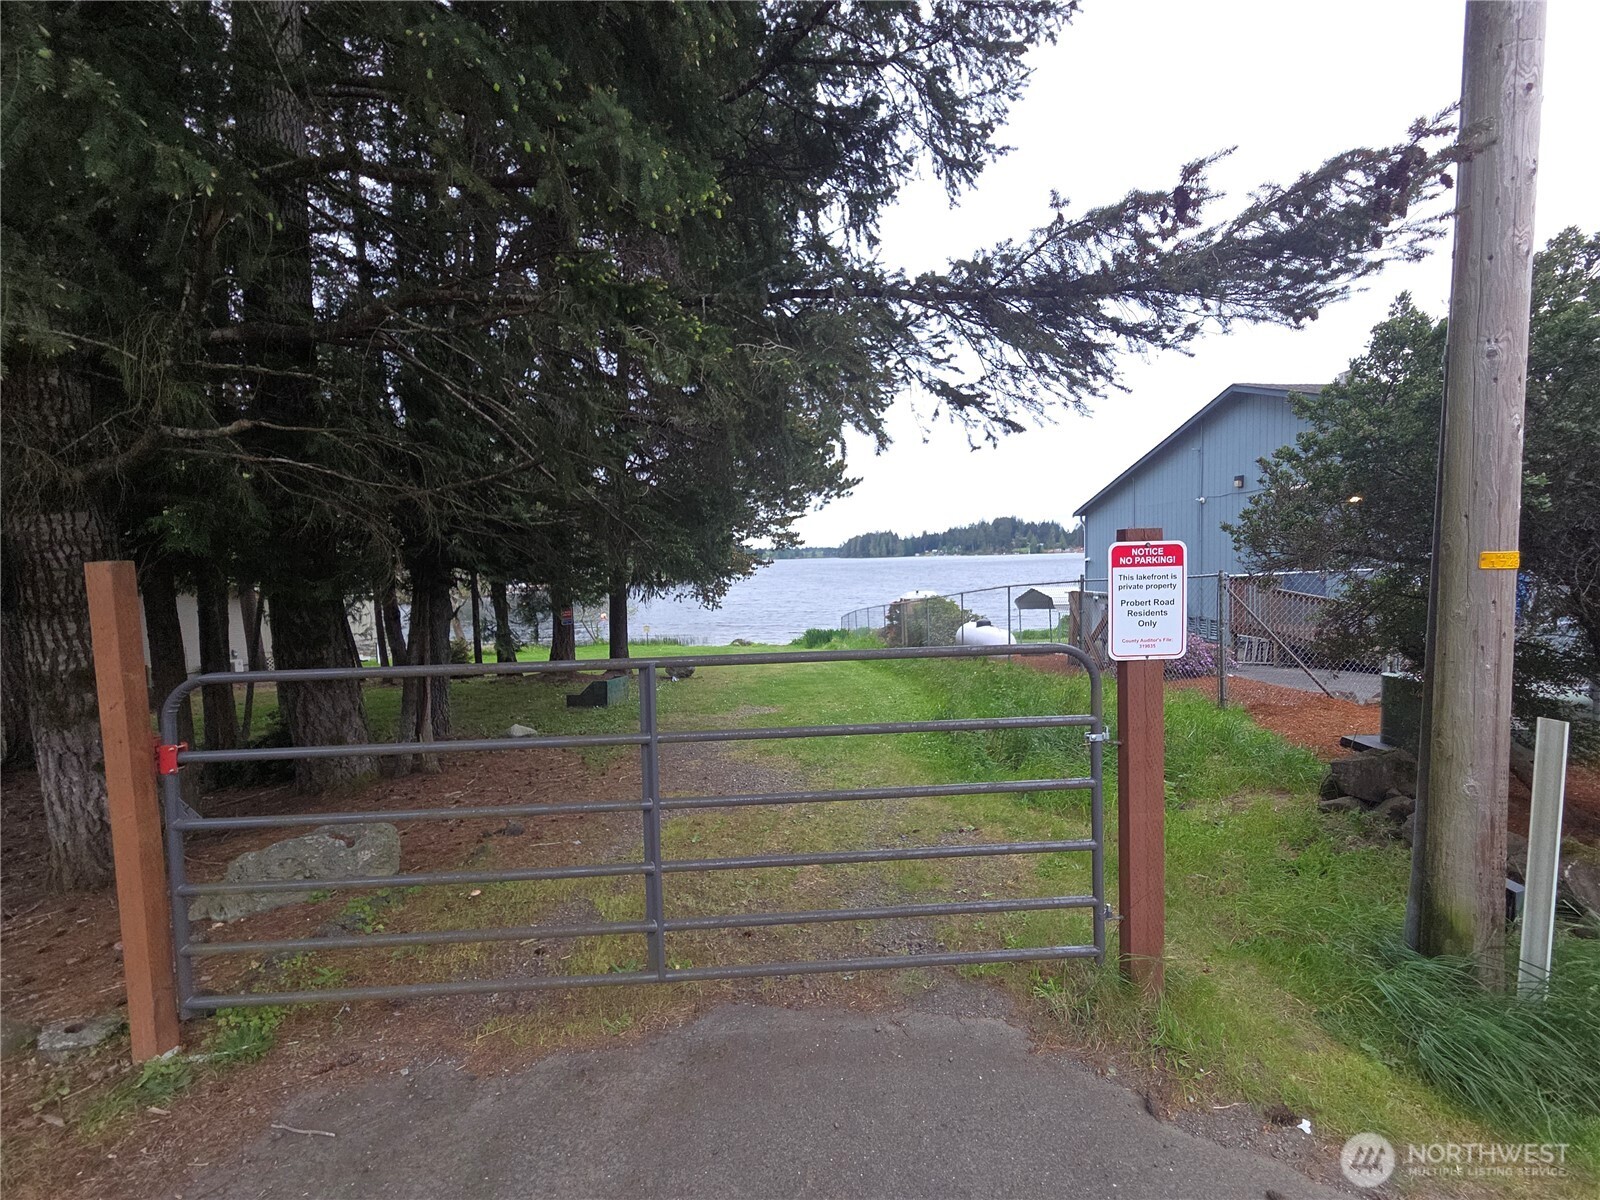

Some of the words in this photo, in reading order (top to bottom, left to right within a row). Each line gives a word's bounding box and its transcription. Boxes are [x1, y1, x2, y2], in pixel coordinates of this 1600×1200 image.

[1131, 547, 1164, 556] NOTICE
[1119, 556, 1133, 565] NO
[1134, 555, 1176, 565] PARKING!
[1118, 583, 1144, 591] private
[1145, 582, 1177, 591] property
[1120, 599, 1151, 607] Probert
[1153, 598, 1175, 606] Road
[1127, 609, 1168, 617] Residents
[1138, 620, 1157, 628] Only
